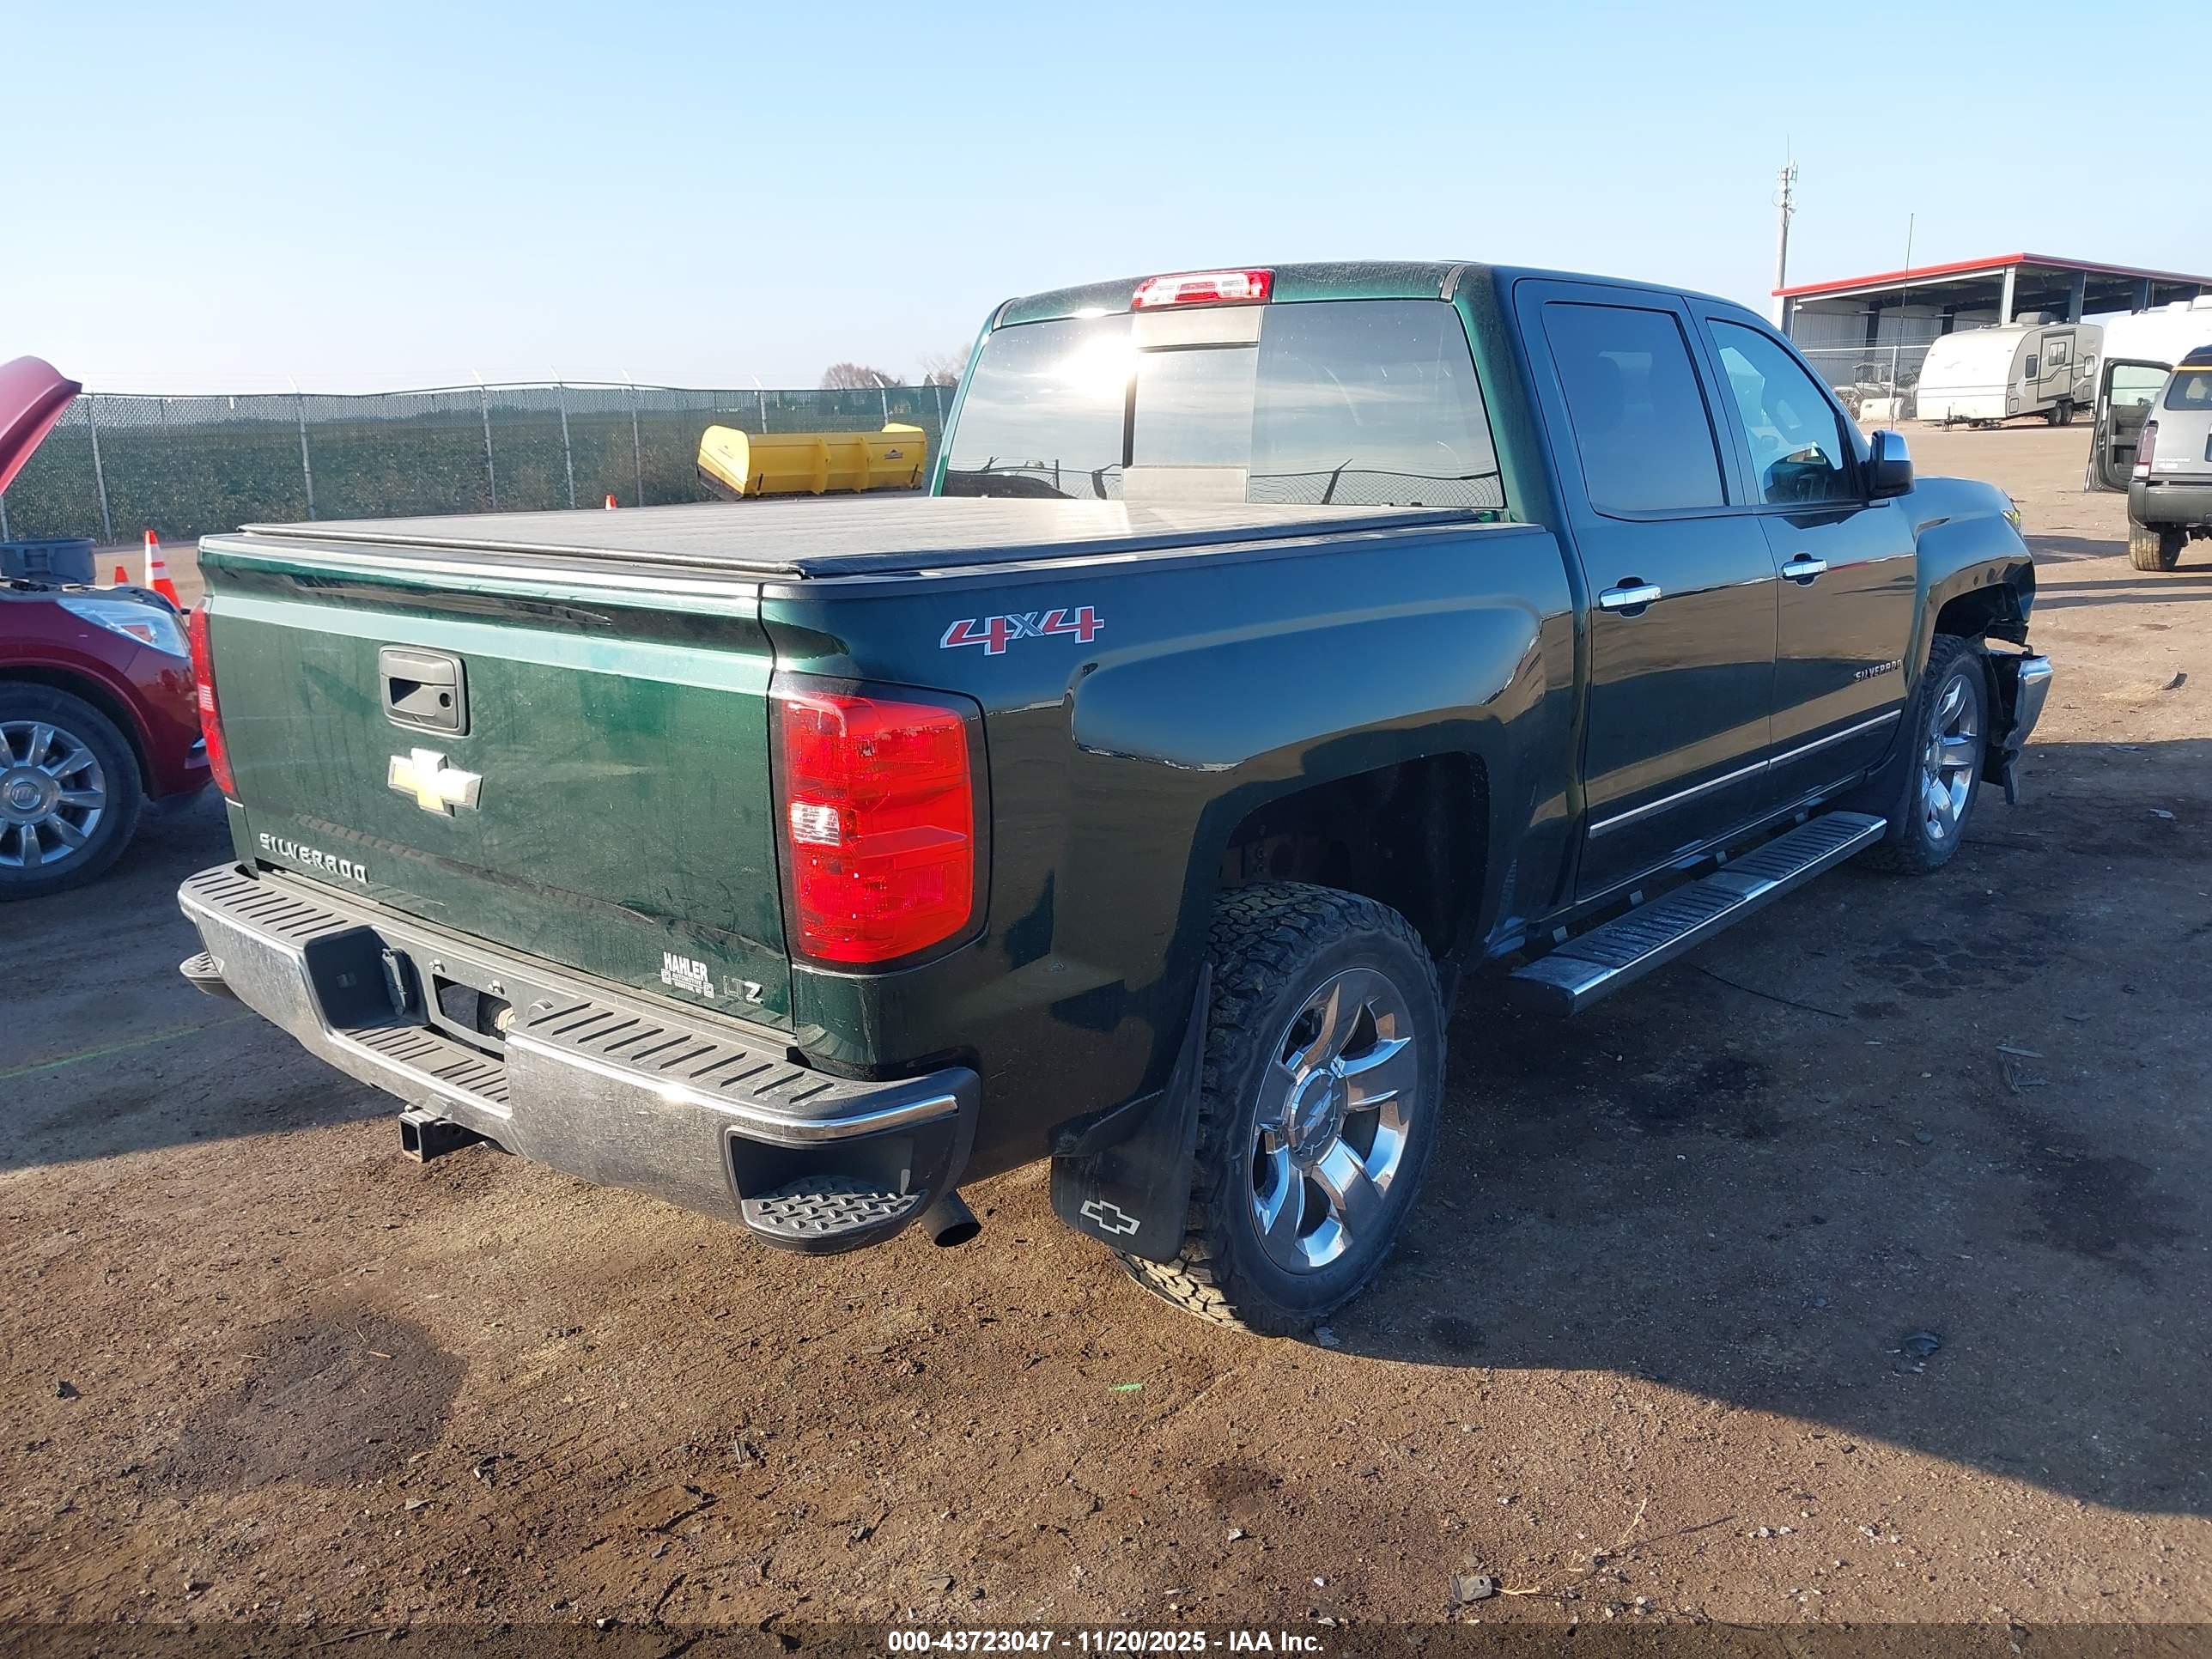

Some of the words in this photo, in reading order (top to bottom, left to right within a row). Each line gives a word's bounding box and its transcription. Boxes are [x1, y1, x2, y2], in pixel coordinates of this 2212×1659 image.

[1855, 659, 1903, 683] SILVERADO
[259, 832, 369, 884] SILVERADO
[663, 951, 708, 983] HAHLER
[722, 975, 764, 1004] LTZ
